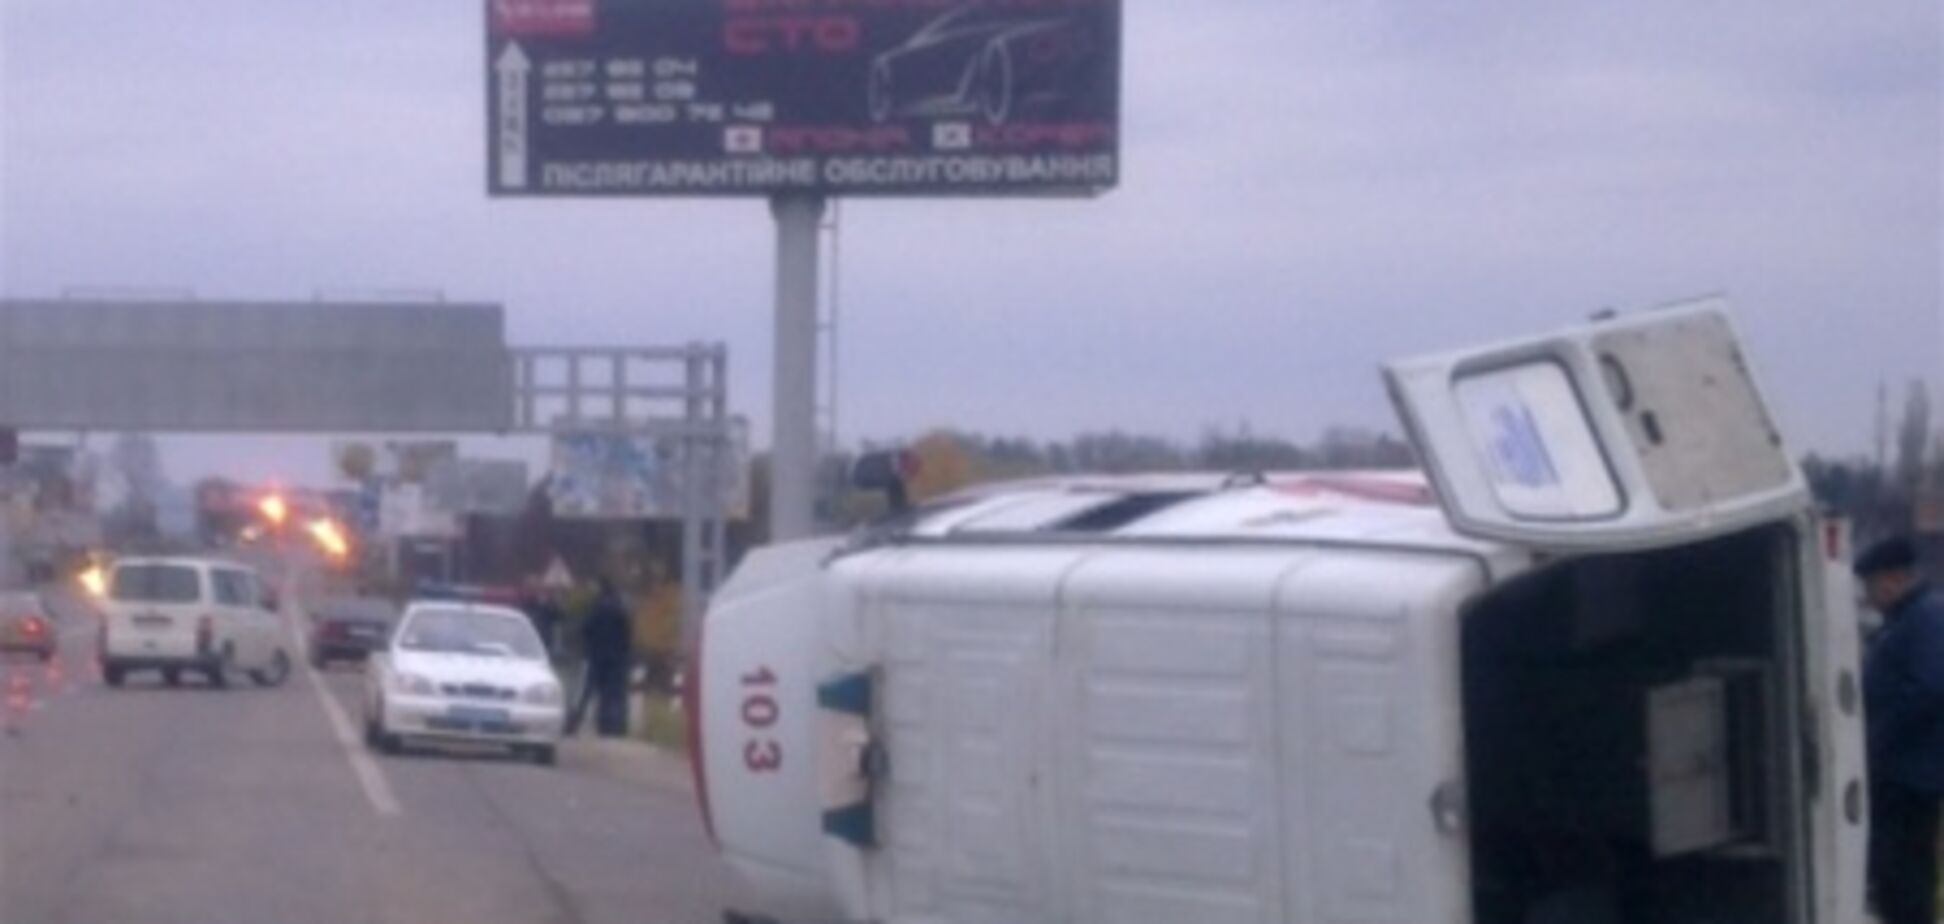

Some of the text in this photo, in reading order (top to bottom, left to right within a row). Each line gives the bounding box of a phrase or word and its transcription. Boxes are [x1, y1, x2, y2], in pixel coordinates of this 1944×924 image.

[724, 17, 860, 52] СТО
[824, 154, 1112, 185] ОБСЛУГОВУВАННЯ
[740, 665, 783, 774] 103
